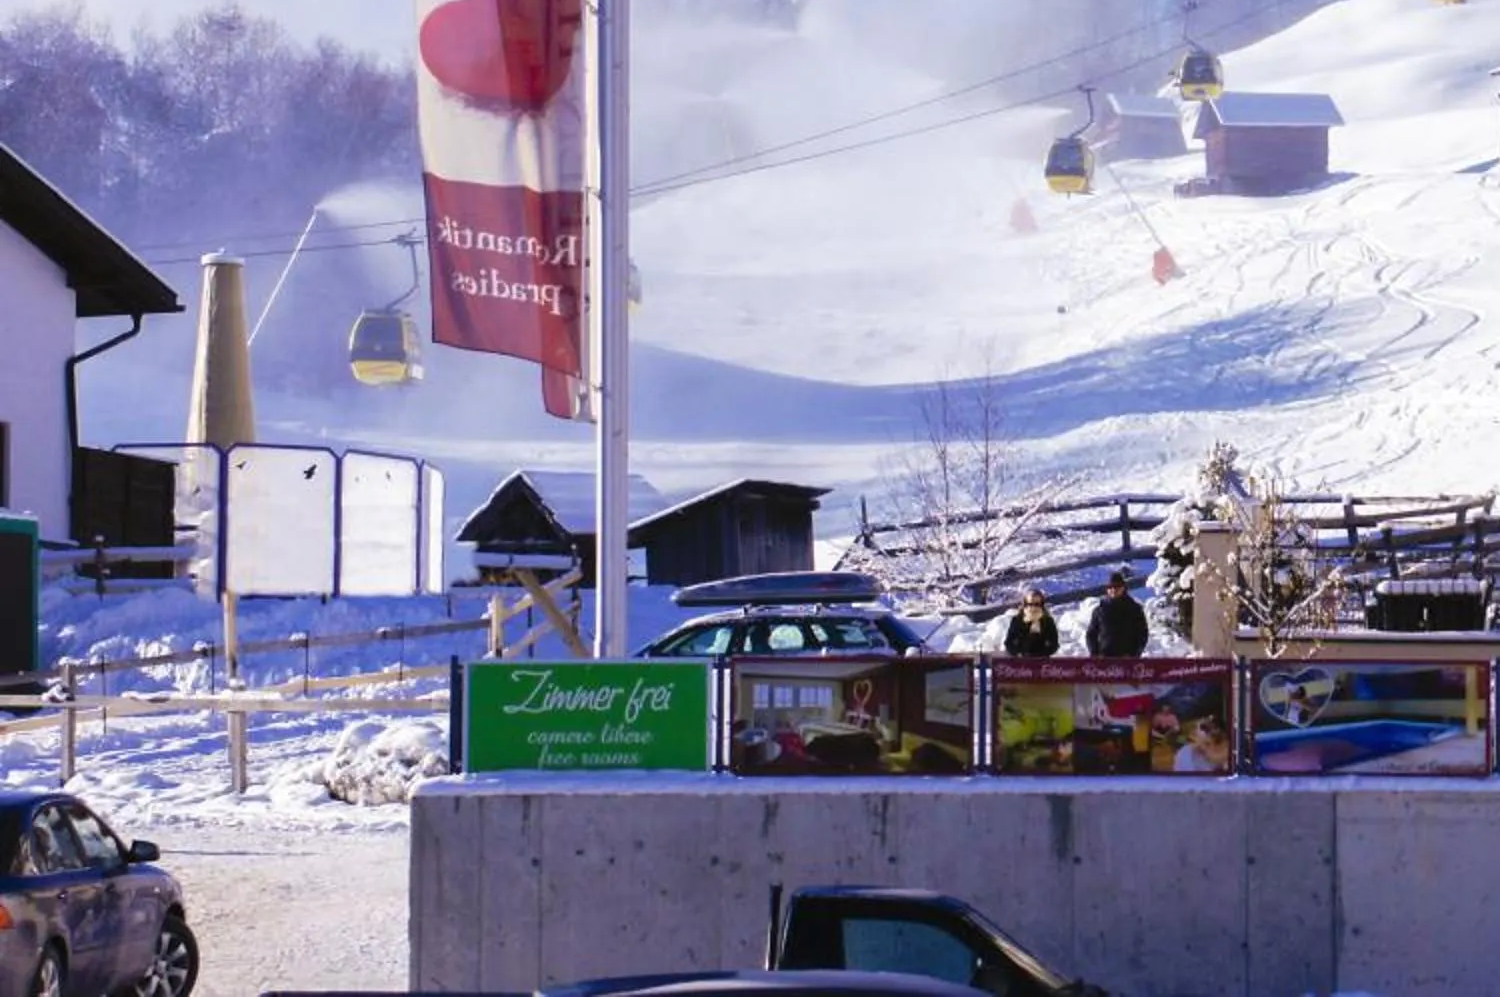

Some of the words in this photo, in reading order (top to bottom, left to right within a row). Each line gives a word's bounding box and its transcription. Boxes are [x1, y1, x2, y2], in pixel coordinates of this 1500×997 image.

[503, 670, 624, 714] Zimmer
[625, 678, 675, 723] frei
[527, 729, 595, 745] camere
[600, 723, 653, 745] libere
[537, 744, 577, 770] free
[580, 750, 641, 765] rooms
